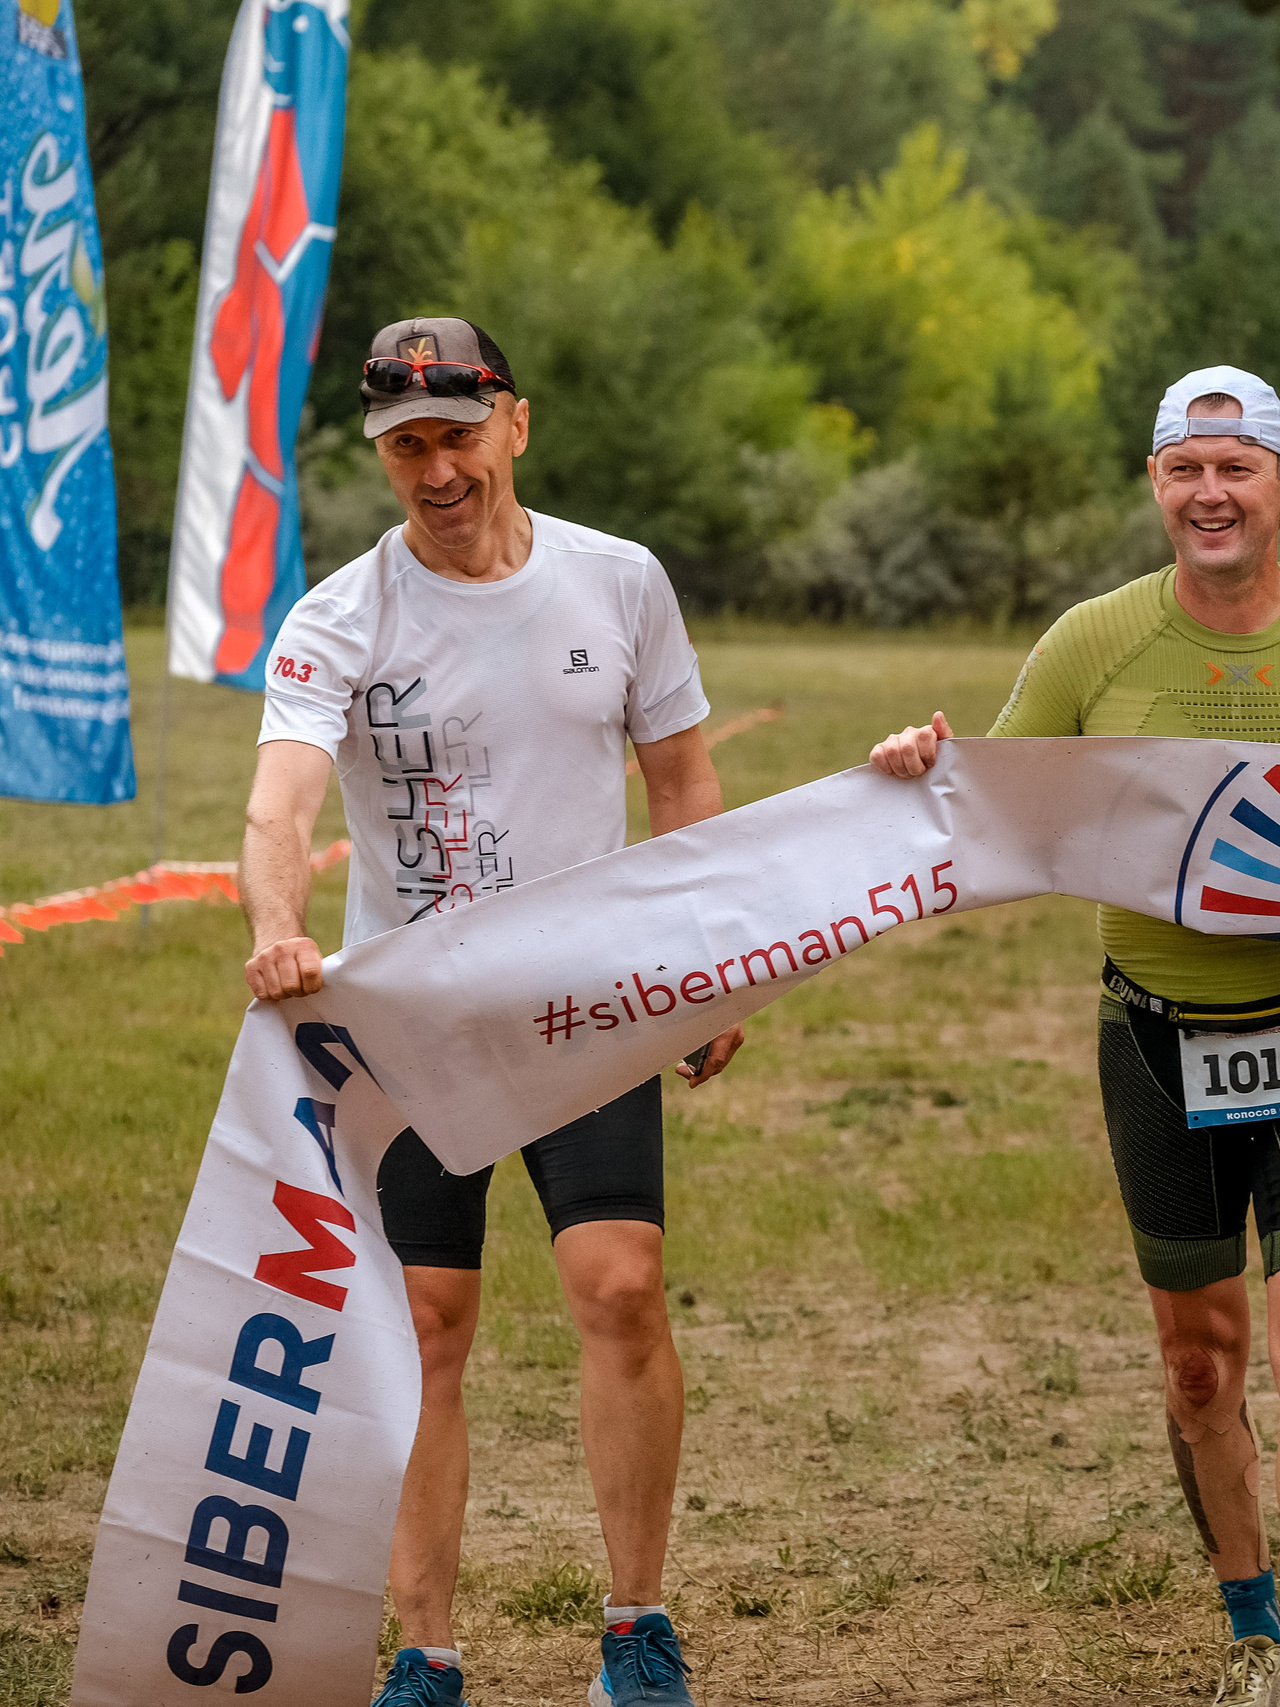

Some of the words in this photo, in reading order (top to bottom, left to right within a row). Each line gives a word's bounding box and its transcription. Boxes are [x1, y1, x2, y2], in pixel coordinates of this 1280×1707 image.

[273, 655, 313, 683] 70.3
[562, 665, 600, 675] salomon
[533, 860, 958, 1045] #siberman515
[1226, 1107, 1277, 1120] КОПОСОВ
